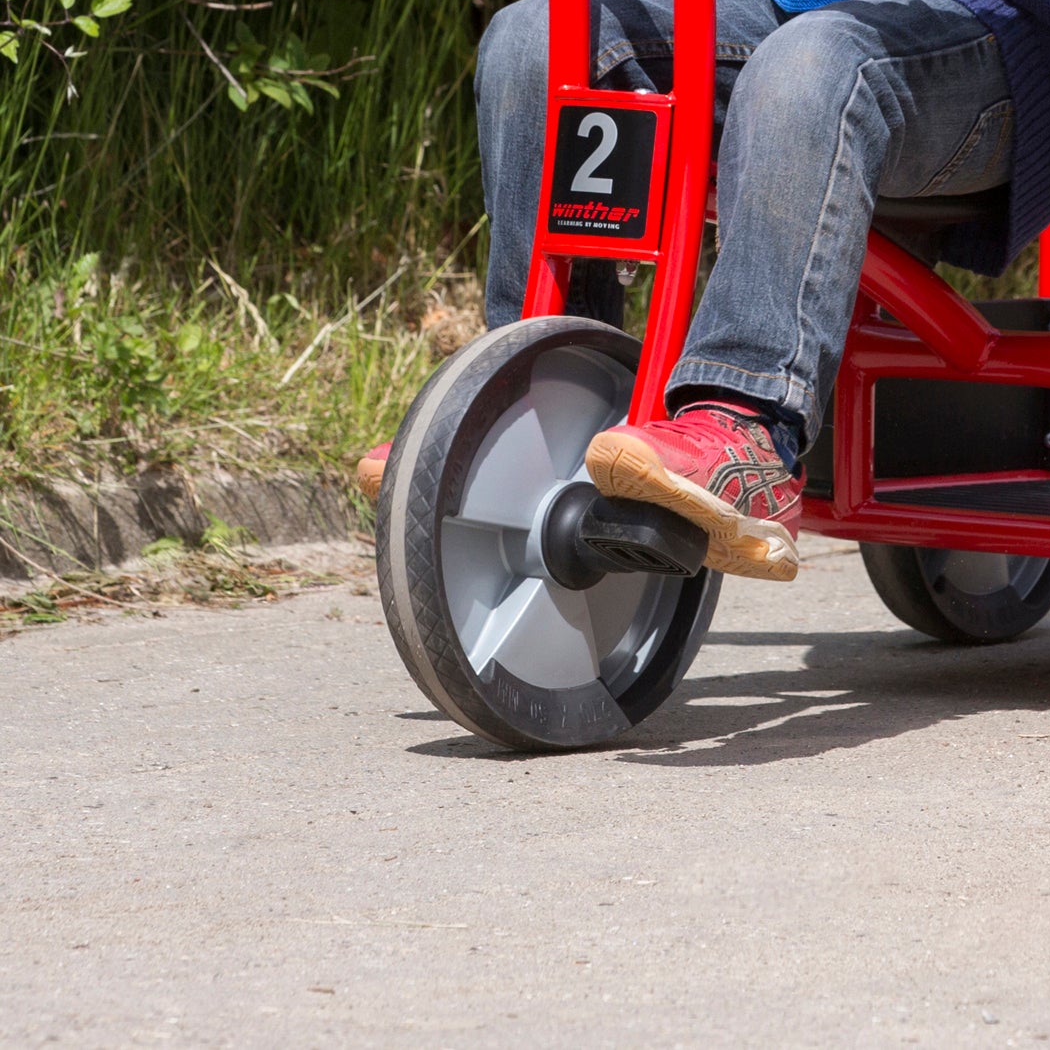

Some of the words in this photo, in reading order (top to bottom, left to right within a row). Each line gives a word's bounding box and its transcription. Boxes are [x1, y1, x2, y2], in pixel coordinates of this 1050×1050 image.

[570, 111, 618, 195] 2
[552, 200, 640, 222] winther
[557, 219, 583, 227] LEARNING
[592, 221, 620, 230] MOVING
